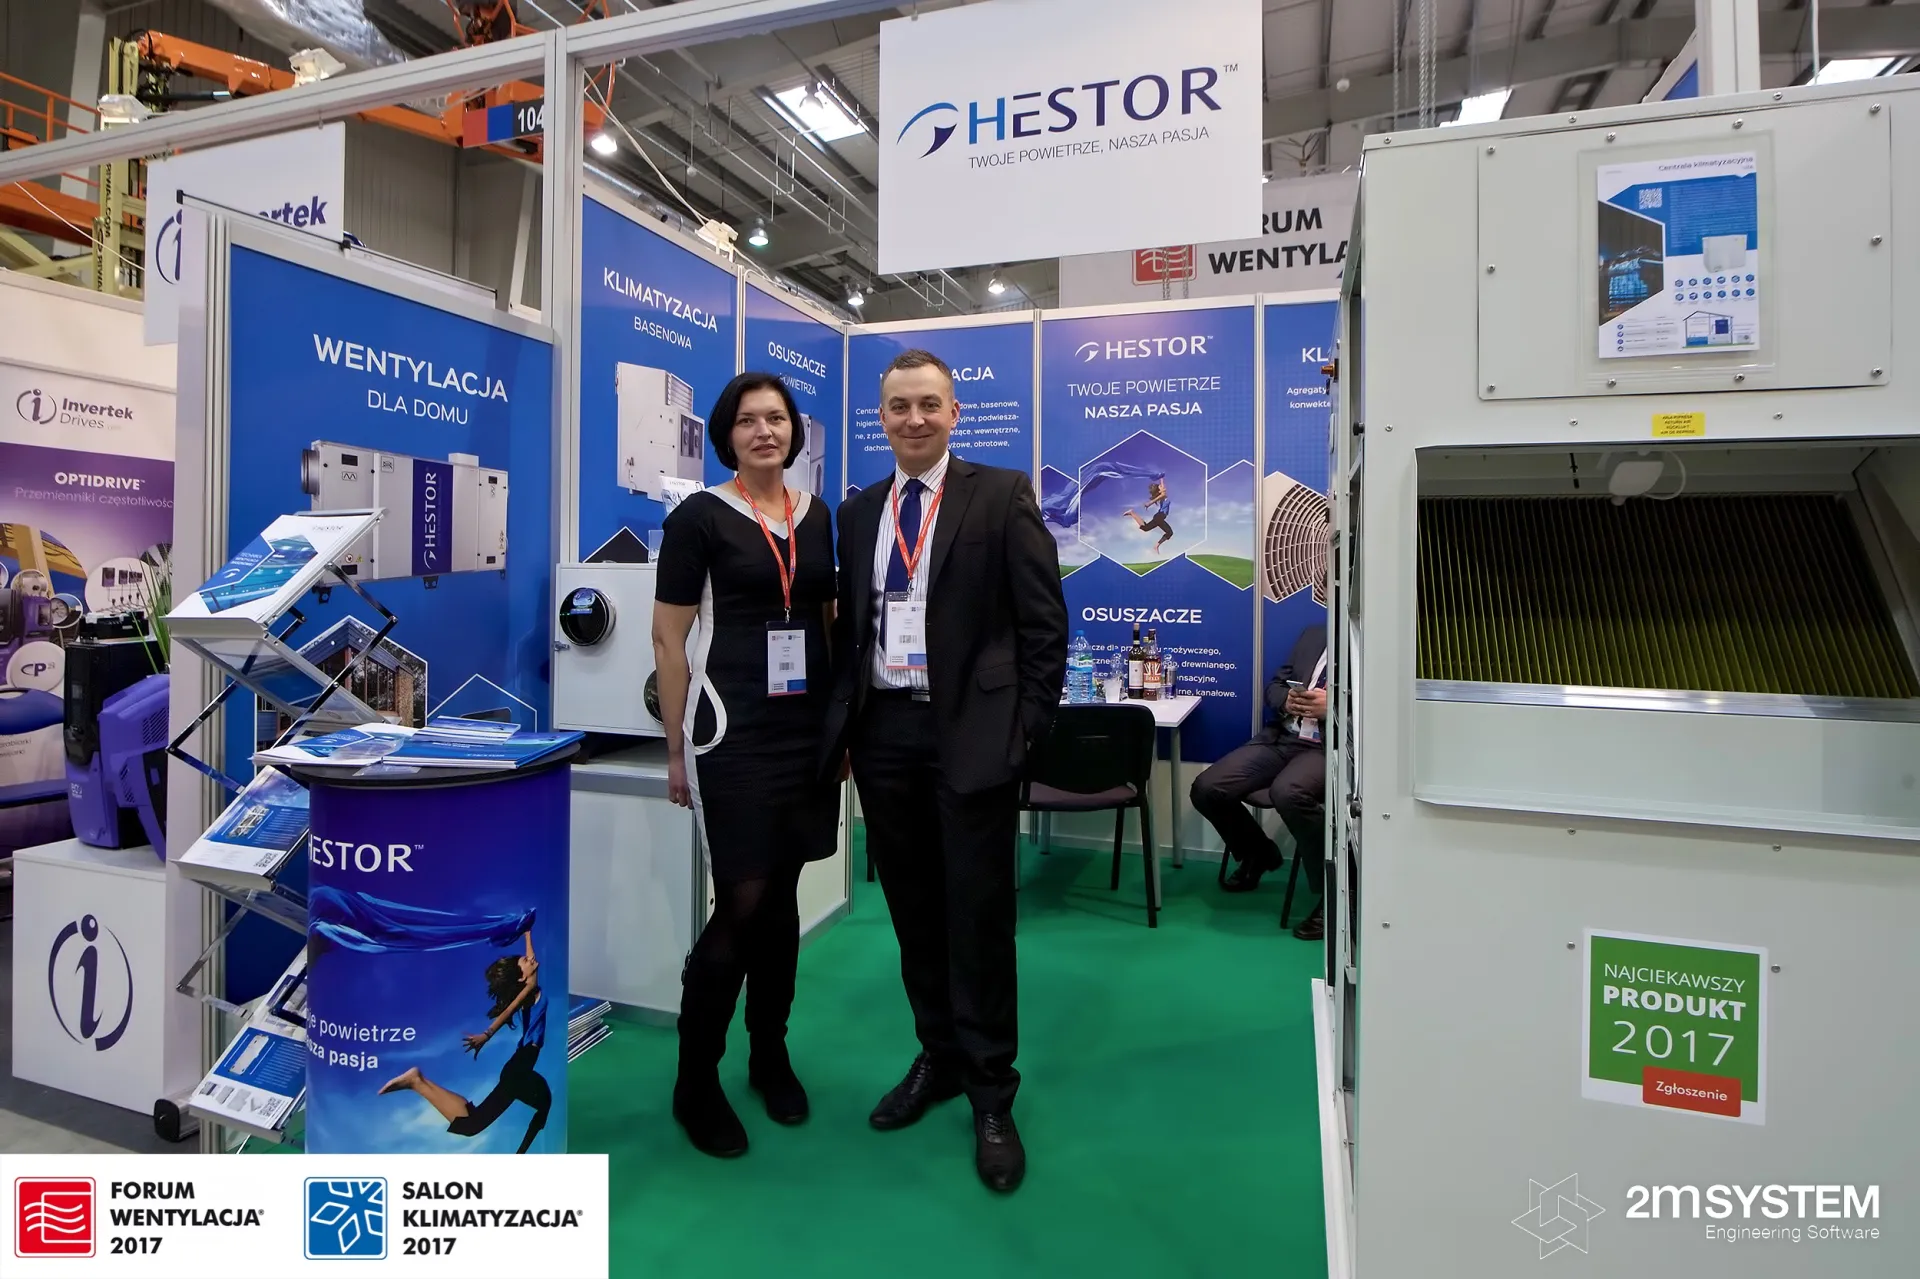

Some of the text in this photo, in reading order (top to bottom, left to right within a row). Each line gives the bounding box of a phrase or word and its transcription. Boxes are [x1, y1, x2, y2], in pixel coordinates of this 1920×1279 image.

[968, 126, 1210, 169] TWOJE POWIETRZE, NASZA PASJA
[603, 266, 718, 333] KLIMATYZACJA
[633, 316, 693, 350] BASENOWA
[312, 334, 508, 403] WENTYLACJA
[768, 341, 826, 379] OSUSZACZE
[1067, 376, 1221, 397] TWOJE POWIETRZE
[62, 398, 133, 420] Invertek
[367, 389, 469, 426] DLA DOMU
[1084, 402, 1203, 419] NASZA PASJA
[60, 413, 104, 429] Drives
[15, 487, 95, 503] Przemienniki
[1082, 607, 1203, 624] OSUSZACZE
[1604, 963, 1746, 993] NAJCIEKAWSZY
[1603, 984, 1746, 1022] PRODUKT
[319, 1019, 417, 1042] powietrze
[1611, 1020, 1735, 1067] 2017
[329, 1049, 379, 1072] pasja
[1655, 1080, 1728, 1102] Zgłoszenie
